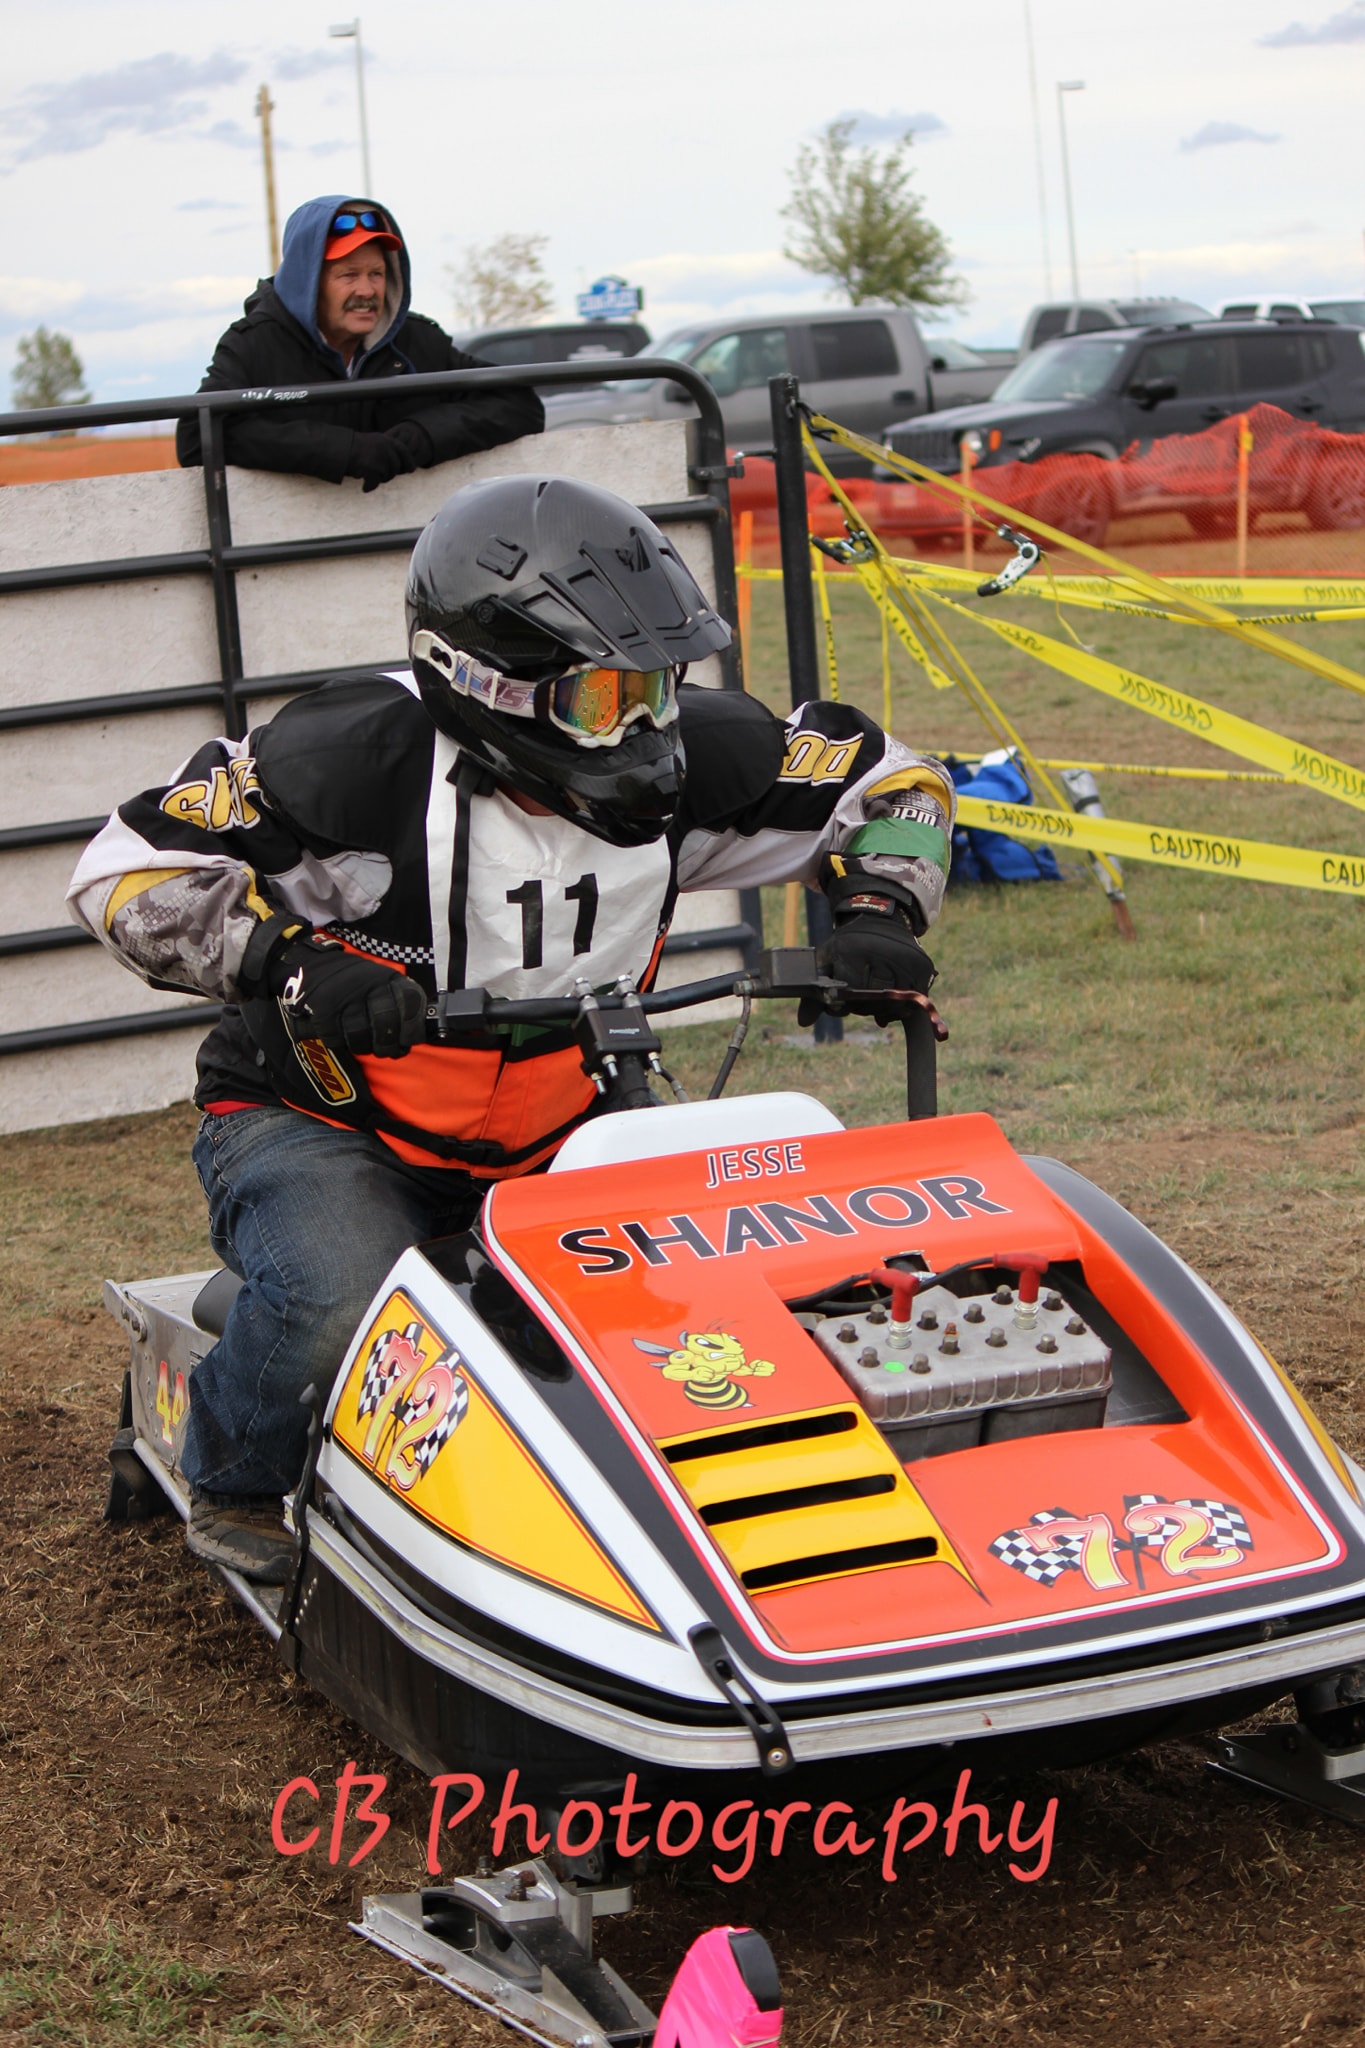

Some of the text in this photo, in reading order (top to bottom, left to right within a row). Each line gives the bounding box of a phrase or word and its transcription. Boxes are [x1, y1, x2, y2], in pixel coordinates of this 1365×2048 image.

[986, 803, 1365, 888] CAUTION CAUTION CAU
[506, 872, 599, 970] 11
[705, 1142, 806, 1189] JESSE
[557, 1175, 1013, 1276] SHANOR
[362, 1329, 456, 1491] 72
[1018, 1502, 1246, 1591] 72
